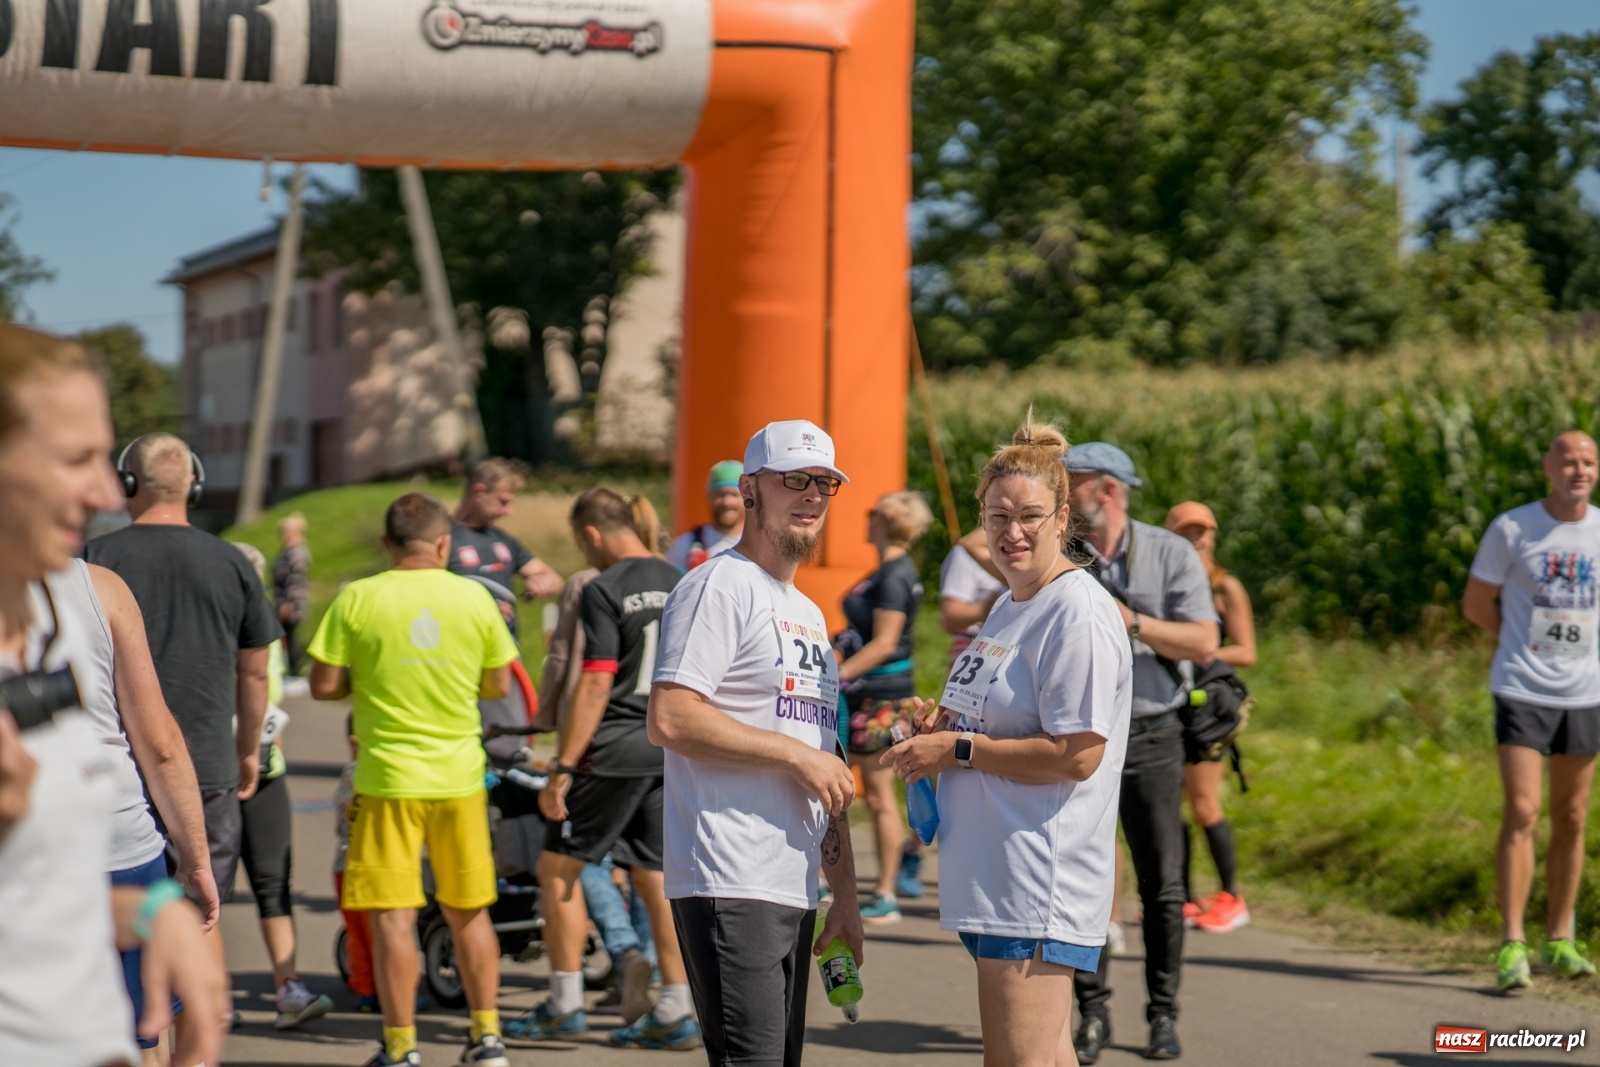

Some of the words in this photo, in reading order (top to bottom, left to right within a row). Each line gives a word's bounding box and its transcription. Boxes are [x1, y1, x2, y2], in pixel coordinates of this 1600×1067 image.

[0, 0, 340, 85] TART
[1546, 623, 1581, 643] 48
[793, 638, 828, 675] 24
[948, 654, 985, 686] 23
[776, 696, 819, 726] COLOUR
